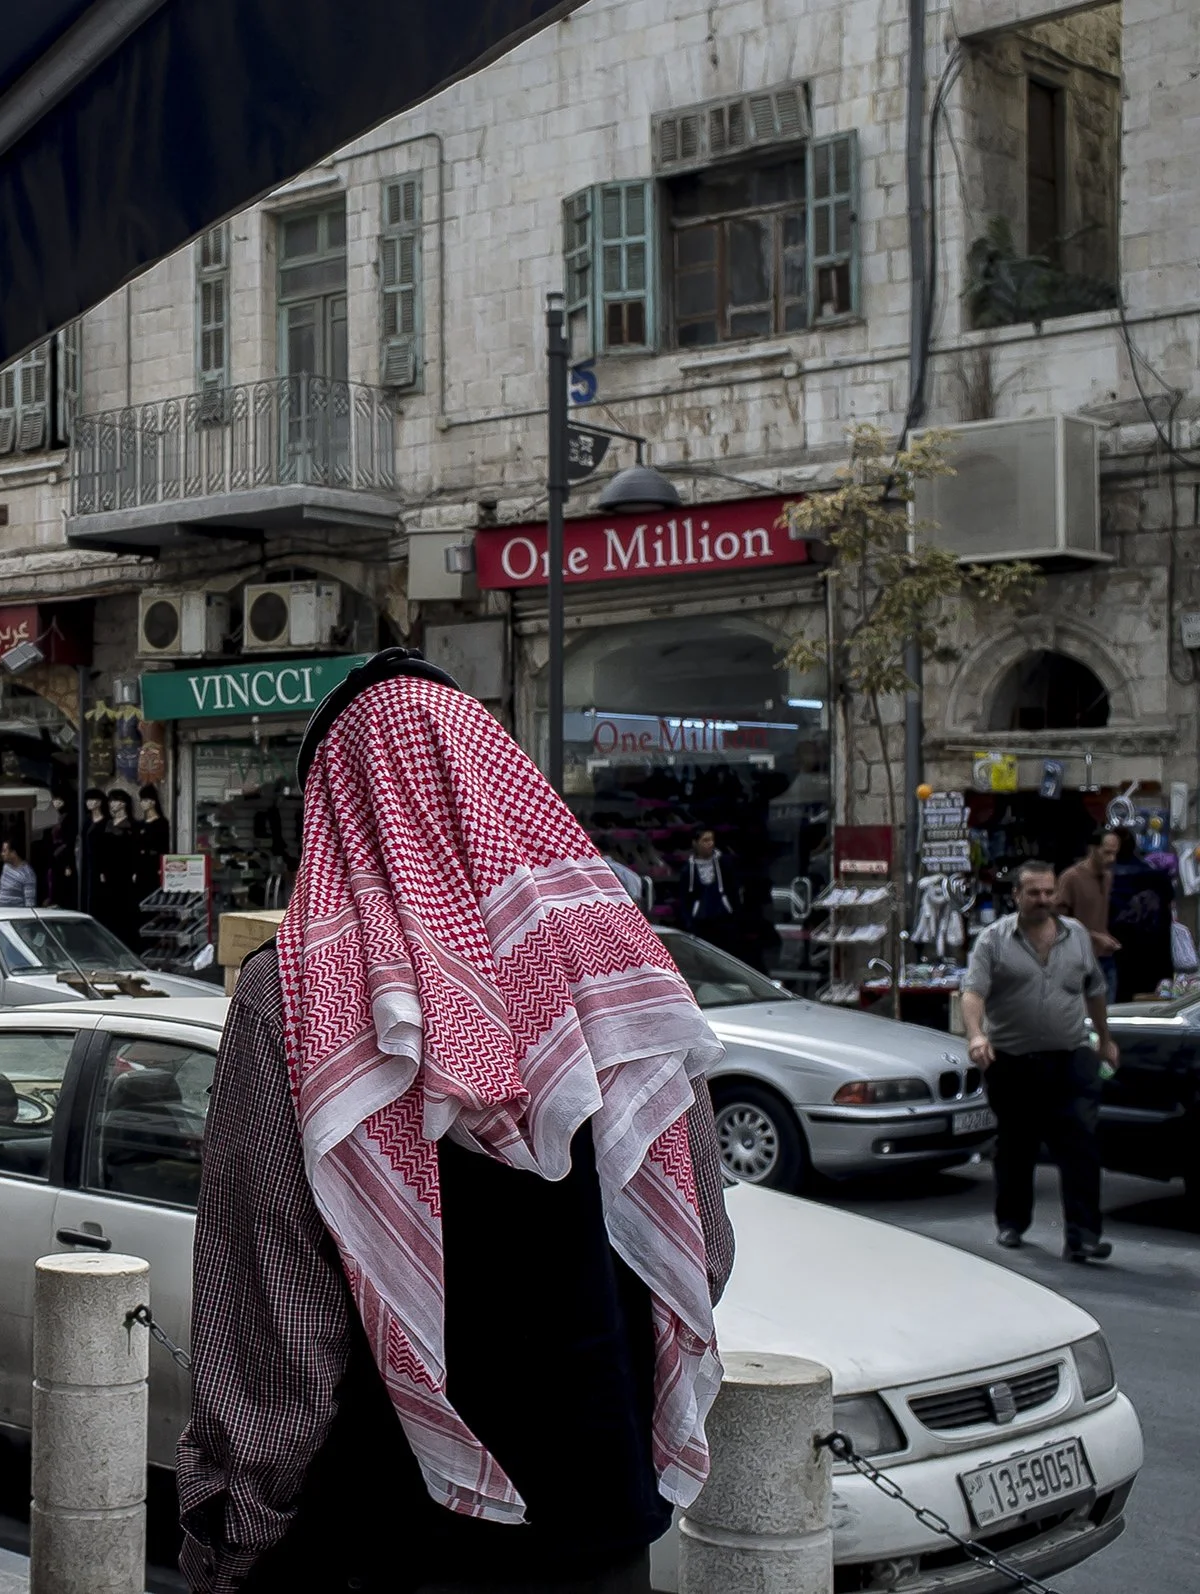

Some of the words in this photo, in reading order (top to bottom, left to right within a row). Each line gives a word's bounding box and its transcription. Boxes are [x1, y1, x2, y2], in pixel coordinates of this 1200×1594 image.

[603, 517, 774, 572] Million
[188, 667, 316, 711] VINCCI
[593, 720, 652, 754] One
[988, 1444, 1082, 1513] 13-59057
